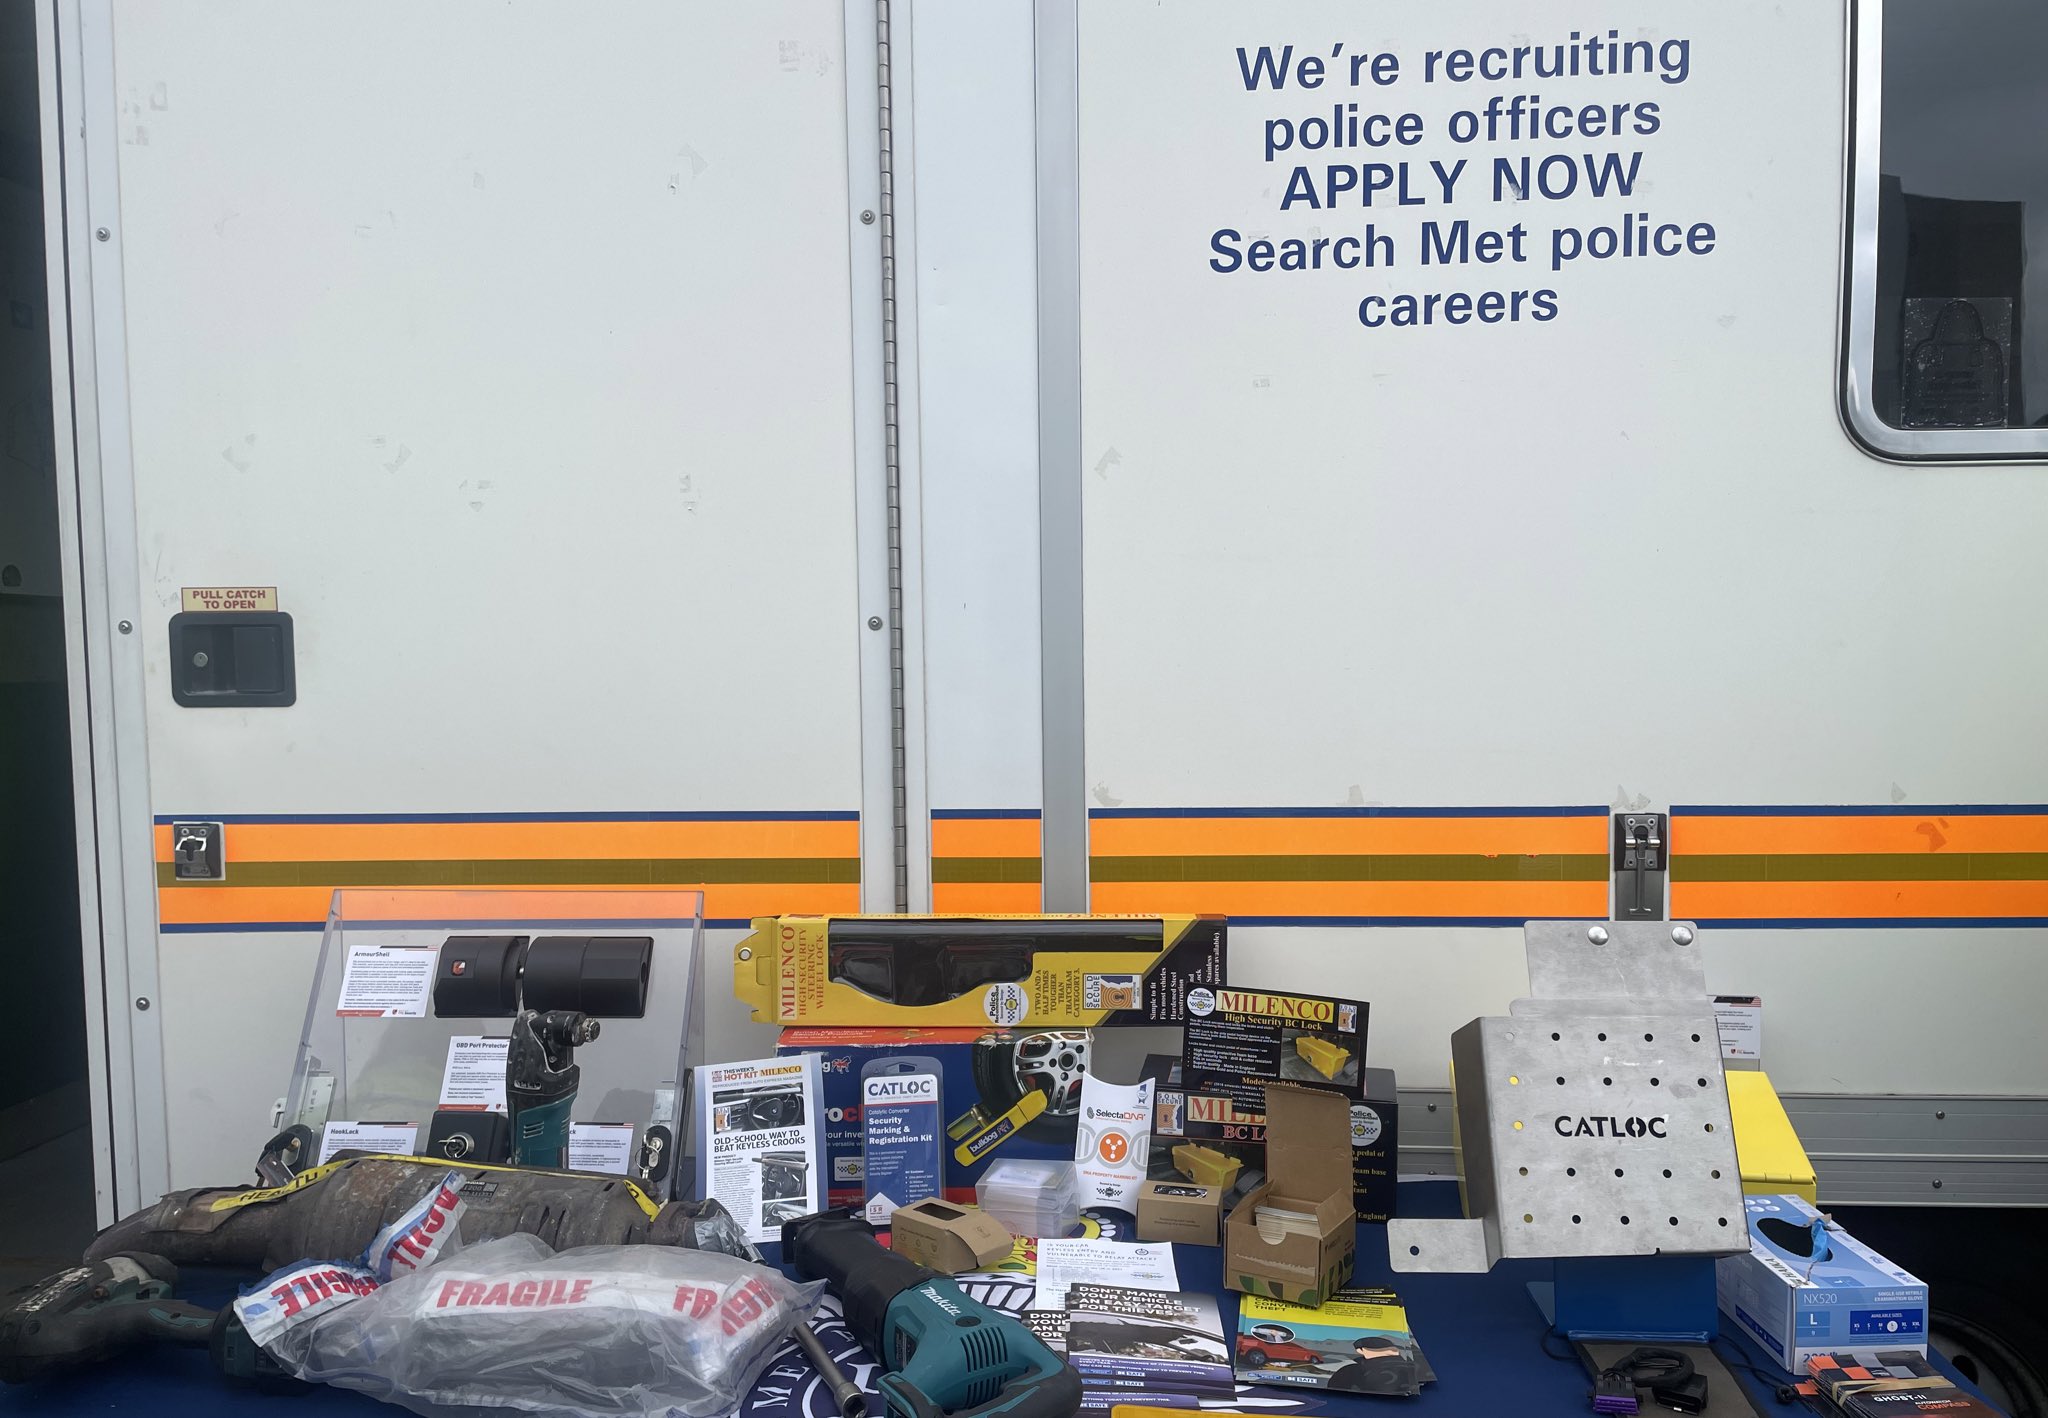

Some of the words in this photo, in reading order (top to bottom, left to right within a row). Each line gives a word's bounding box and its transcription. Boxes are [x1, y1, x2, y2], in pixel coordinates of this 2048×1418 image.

[1236, 43, 1400, 91] We're
[1423, 30, 1691, 84] recruiting
[1264, 104, 1424, 162] police
[1448, 95, 1661, 143] officers
[1280, 160, 1467, 211] APPLY
[1493, 151, 1643, 202] NOW
[1209, 223, 1395, 274] Search
[1421, 220, 1527, 265] Met
[1552, 213, 1717, 271] police
[1358, 289, 1558, 328] careers
[192, 590, 223, 599] PULL
[226, 590, 266, 599] CATCH
[203, 600, 220, 609] TO
[223, 600, 256, 609] OPEN
[799, 928, 807, 987] SECURITY
[816, 934, 824, 969] LOCK
[781, 926, 795, 1017] MILENCO
[816, 971, 824, 1010] WHEEL
[1065, 970, 1073, 1016] THATCHAM
[799, 988, 807, 1016] HIGH
[1150, 997, 1158, 1020] Simple
[1221, 992, 1331, 1021] MILENCO
[1224, 1012, 1246, 1023] High
[1247, 1015, 1283, 1027] Security
[1285, 1020, 1299, 1029] BC
[1301, 1021, 1323, 1031] Lock
[724, 1072, 742, 1081] HOT
[744, 1071, 759, 1079] KIT
[760, 1065, 803, 1077] MILENCO
[868, 1080, 931, 1097] CATLOC
[868, 1116, 903, 1125] Security
[1554, 1115, 1667, 1139] CATLOC
[714, 1133, 767, 1146] OLD-SCHOOL
[768, 1131, 788, 1140] WAY
[789, 1129, 800, 1138] TO
[868, 1126, 902, 1135] Marking
[903, 1125, 911, 1133] &
[1222, 1124, 1248, 1140] BC
[714, 1143, 737, 1153] BEAT
[736, 1140, 771, 1151] KEYLESS
[772, 1136, 806, 1148] CROOKS
[869, 1135, 919, 1146] Registration
[920, 1134, 933, 1142] Kit
[969, 1131, 999, 1153] bulldog
[1356, 1150, 1376, 1158] pedal
[1371, 1168, 1387, 1176] base
[1358, 1212, 1387, 1221] England
[435, 1279, 593, 1308] FRAGILE
[1079, 1286, 1123, 1295] DON'T
[1126, 1290, 1167, 1299] MAKE
[1079, 1291, 1119, 1300] YOUR
[1122, 1295, 1183, 1306] VEHICLE
[1803, 1293, 1838, 1304] NX520
[672, 1284, 718, 1320] FR
[1079, 1297, 1102, 1305] AN
[1104, 1299, 1141, 1308] EASY
[1142, 1302, 1201, 1313] TARGET
[1079, 1303, 1110, 1312] FOR
[1112, 1305, 1179, 1316] THIEVES.
[1810, 1313, 1818, 1326] L
[1296, 1376, 1318, 1384] SAFE
[1873, 1394, 1928, 1402] GHOST-II
[1917, 1401, 1972, 1410] COMPASS
